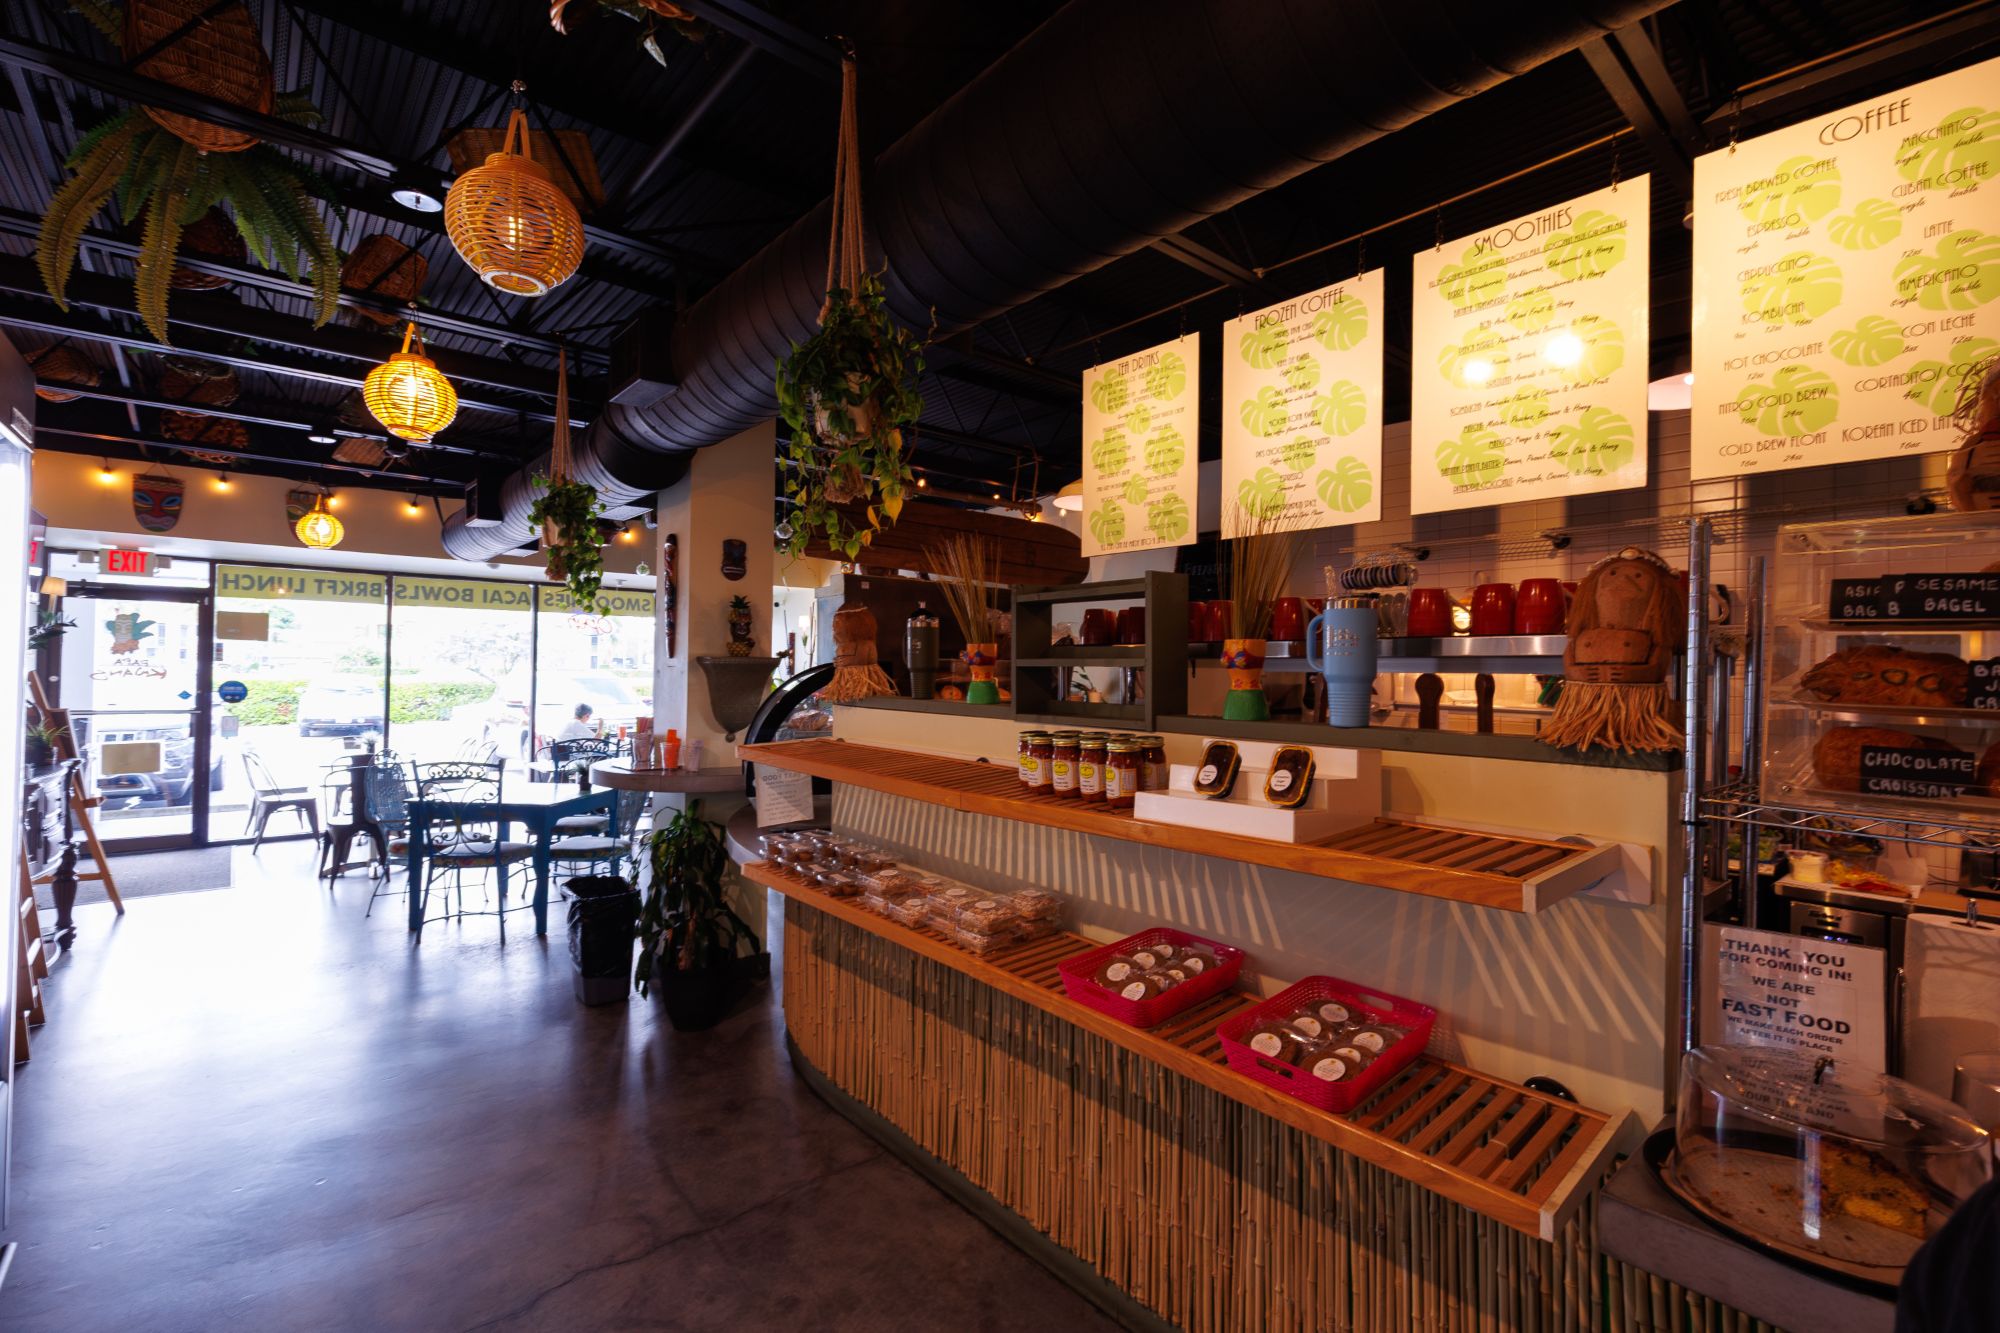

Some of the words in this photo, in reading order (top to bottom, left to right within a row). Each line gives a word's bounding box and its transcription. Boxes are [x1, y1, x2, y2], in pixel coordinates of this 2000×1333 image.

[1819, 97, 1912, 145] COFFEE
[1901, 115, 1978, 149] MACCHIATO
[1953, 131, 1984, 149] double
[1746, 172, 1790, 194] BREWED
[1793, 157, 1837, 180] COFFEE
[1892, 178, 1931, 198] CUBAN
[1936, 161, 1989, 186] COFFEE
[1948, 183, 1979, 199] double
[1473, 206, 1572, 257] SMOOTHIES
[1747, 213, 1800, 238] ESPRESSO
[1923, 219, 1955, 238] LATTE
[1737, 255, 1810, 282] CAPPUCCINO
[1899, 264, 1978, 291] AMERICANO
[1255, 303, 1297, 331] FROZEN
[1301, 287, 1344, 314] COFFEE
[1742, 301, 1804, 325] KOMBUCHA
[1901, 321, 1935, 339] CON
[1941, 313, 1976, 332] LECHE
[1118, 360, 1129, 376] TEA
[1132, 351, 1159, 372] DRINKS
[1724, 356, 1750, 372] HOT
[1752, 341, 1825, 366] CHOCOLATE
[1719, 400, 1753, 415] NITRO
[1757, 392, 1793, 408] COLD
[1796, 387, 1829, 403] BREW
[1842, 423, 1894, 442] KOREAN
[1900, 418, 1927, 435] ICED
[1599, 442, 1619, 451] Honey
[1719, 443, 1753, 457] COLD
[1756, 438, 1786, 453] BREW
[1790, 432, 1827, 448] FLOAT
[1584, 466, 1603, 475] Honey
[108, 549, 149, 573] EXIT
[1914, 578, 2000, 591] SESAME
[1924, 598, 1986, 612] BAGEL
[1864, 751, 1973, 772] CHOCOLATE
[1868, 778, 1966, 798] CROISSANT
[1725, 939, 1792, 959] THANK
[1804, 951, 1845, 967] YOU
[1720, 951, 1750, 964] FOR
[1755, 957, 1822, 976] COMING
[1828, 969, 1852, 981] IN!
[1752, 976, 1777, 988] WE
[1782, 982, 1815, 995] ARE
[1766, 994, 1801, 1008] NOT
[1722, 998, 1776, 1019] FAST
[1785, 1011, 1851, 1034] FOOD
[1728, 1015, 1742, 1024] WE
[1745, 1019, 1774, 1030] MAKE
[1776, 1026, 1804, 1037] EACH
[1807, 1032, 1843, 1045] ORDER
[1740, 1027, 1771, 1040] AFTER
[1787, 1037, 1797, 1045] IS
[1799, 1041, 1833, 1052] PLACE
